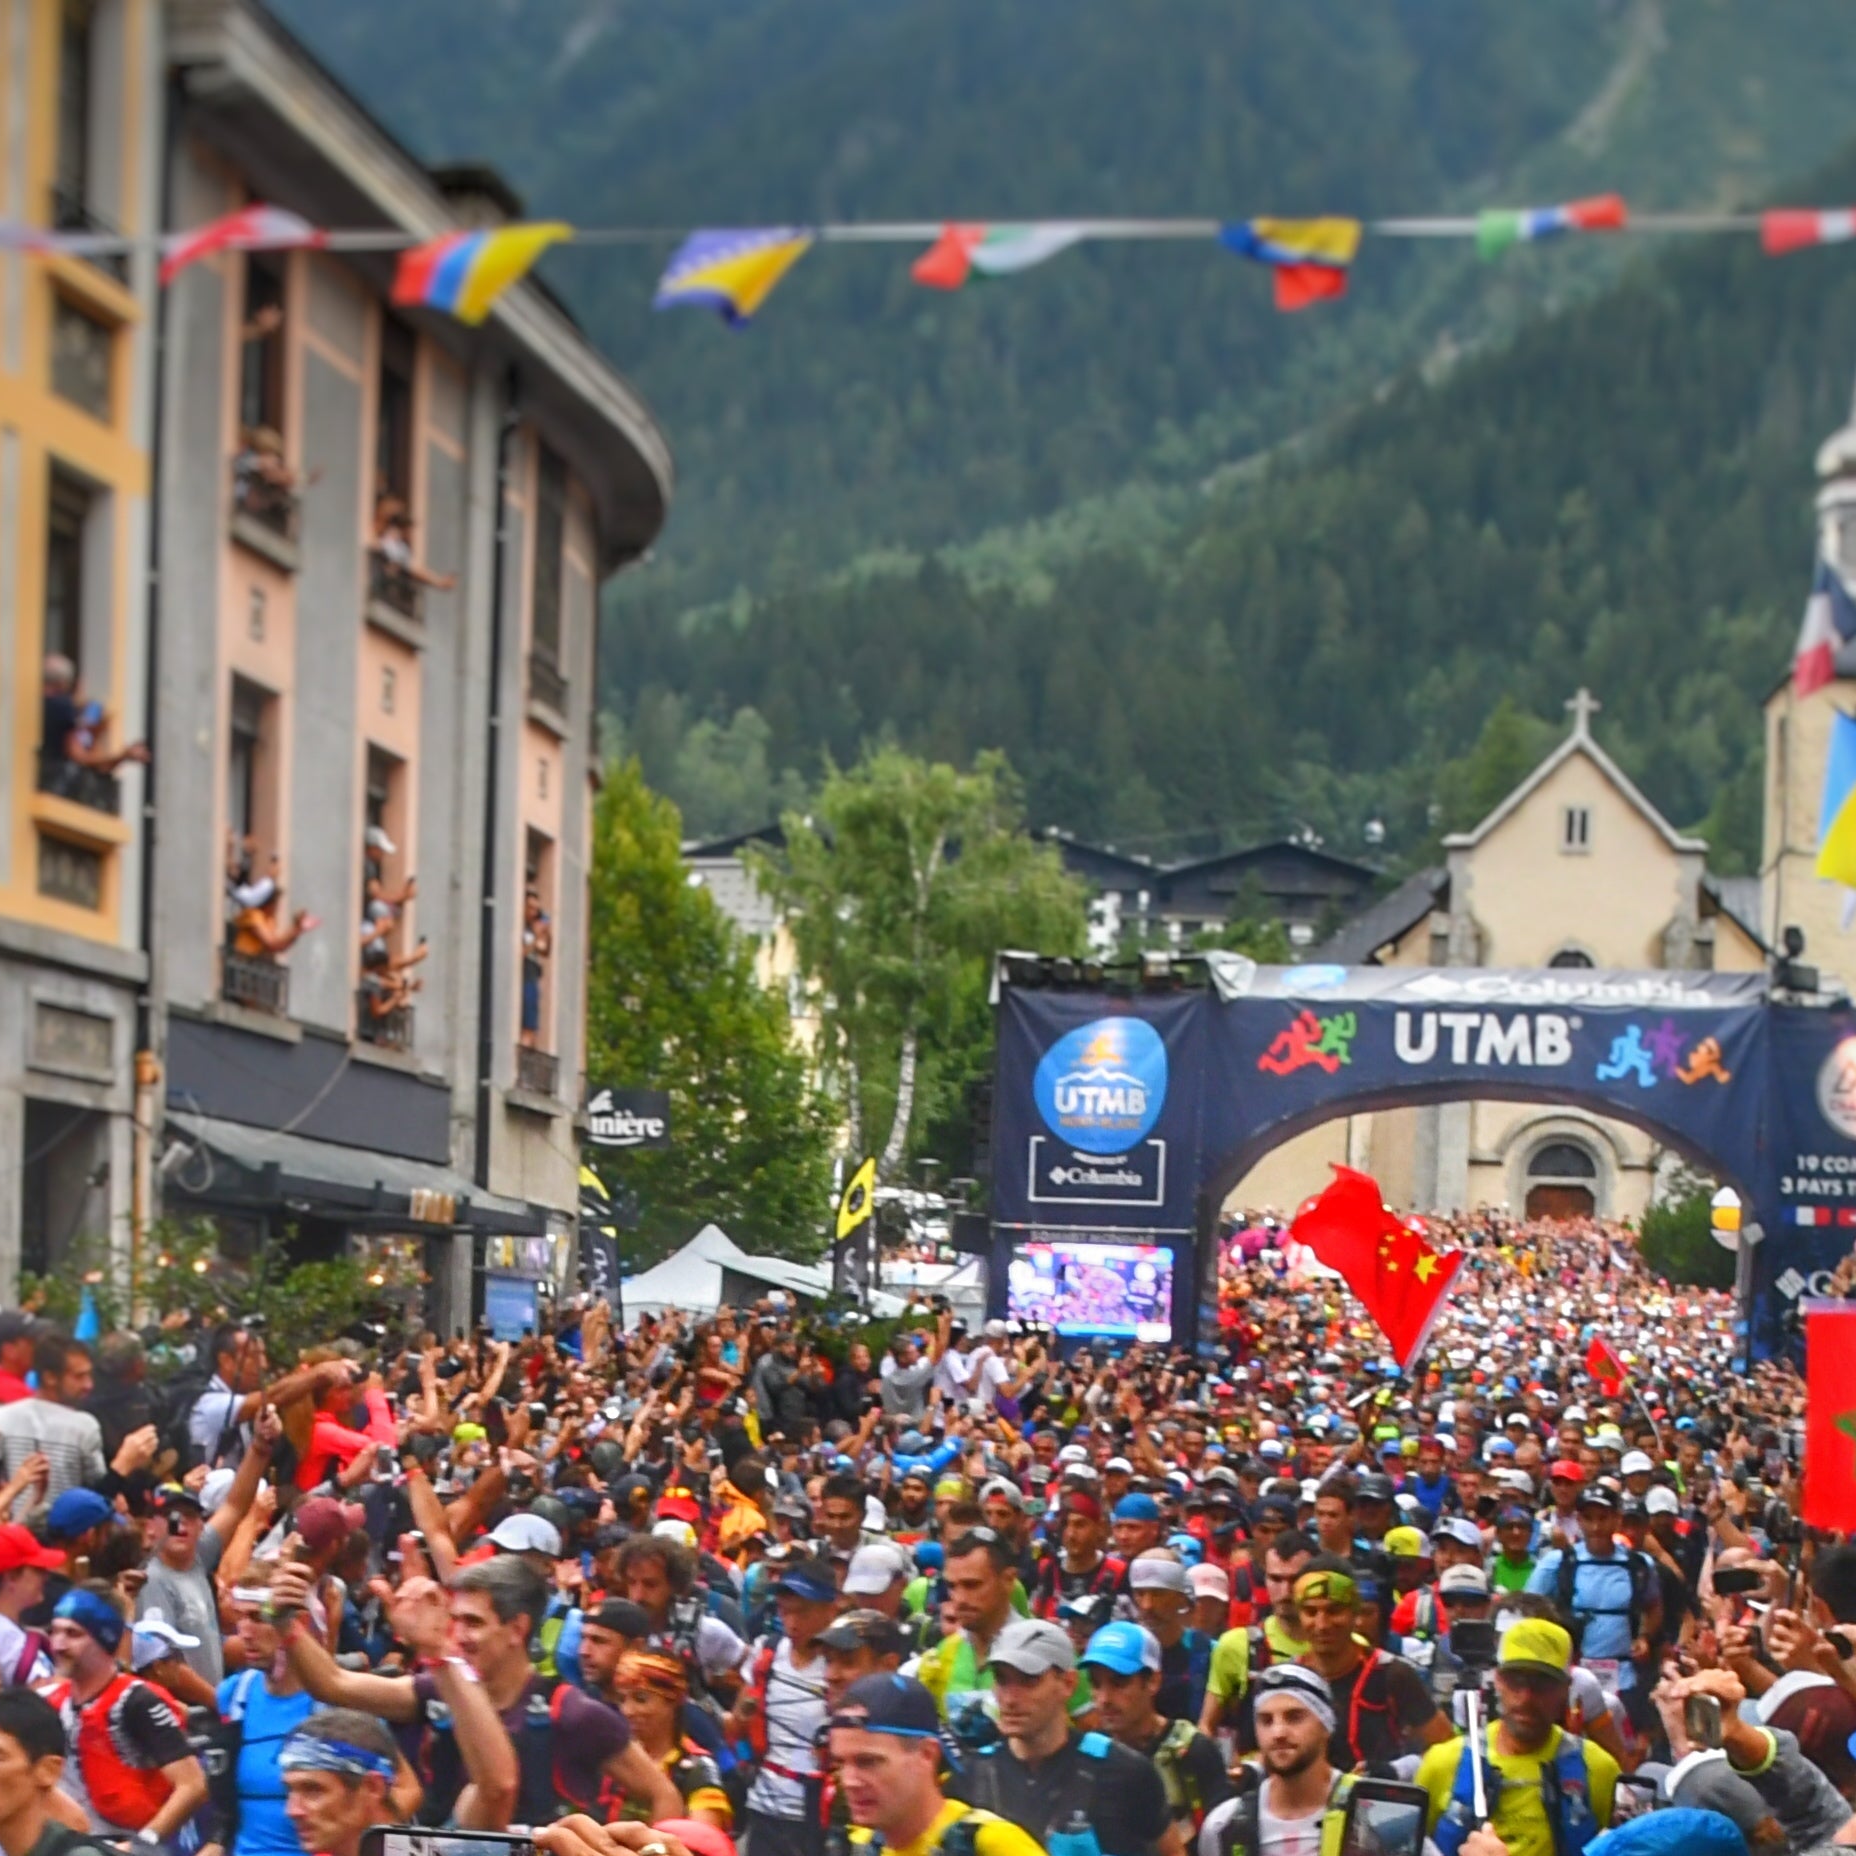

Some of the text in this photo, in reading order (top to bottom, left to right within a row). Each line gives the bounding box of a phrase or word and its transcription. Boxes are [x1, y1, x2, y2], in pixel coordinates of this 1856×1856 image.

[1465, 976, 1712, 1006] Columbia
[1393, 1011, 1574, 1066] UTMB
[1054, 1086, 1147, 1115] UTMB
[1067, 1166, 1143, 1187] Columbia
[1796, 1155, 1820, 1174] 19
[1780, 1176, 1794, 1195] 3
[1797, 1176, 1843, 1196] PAYS
